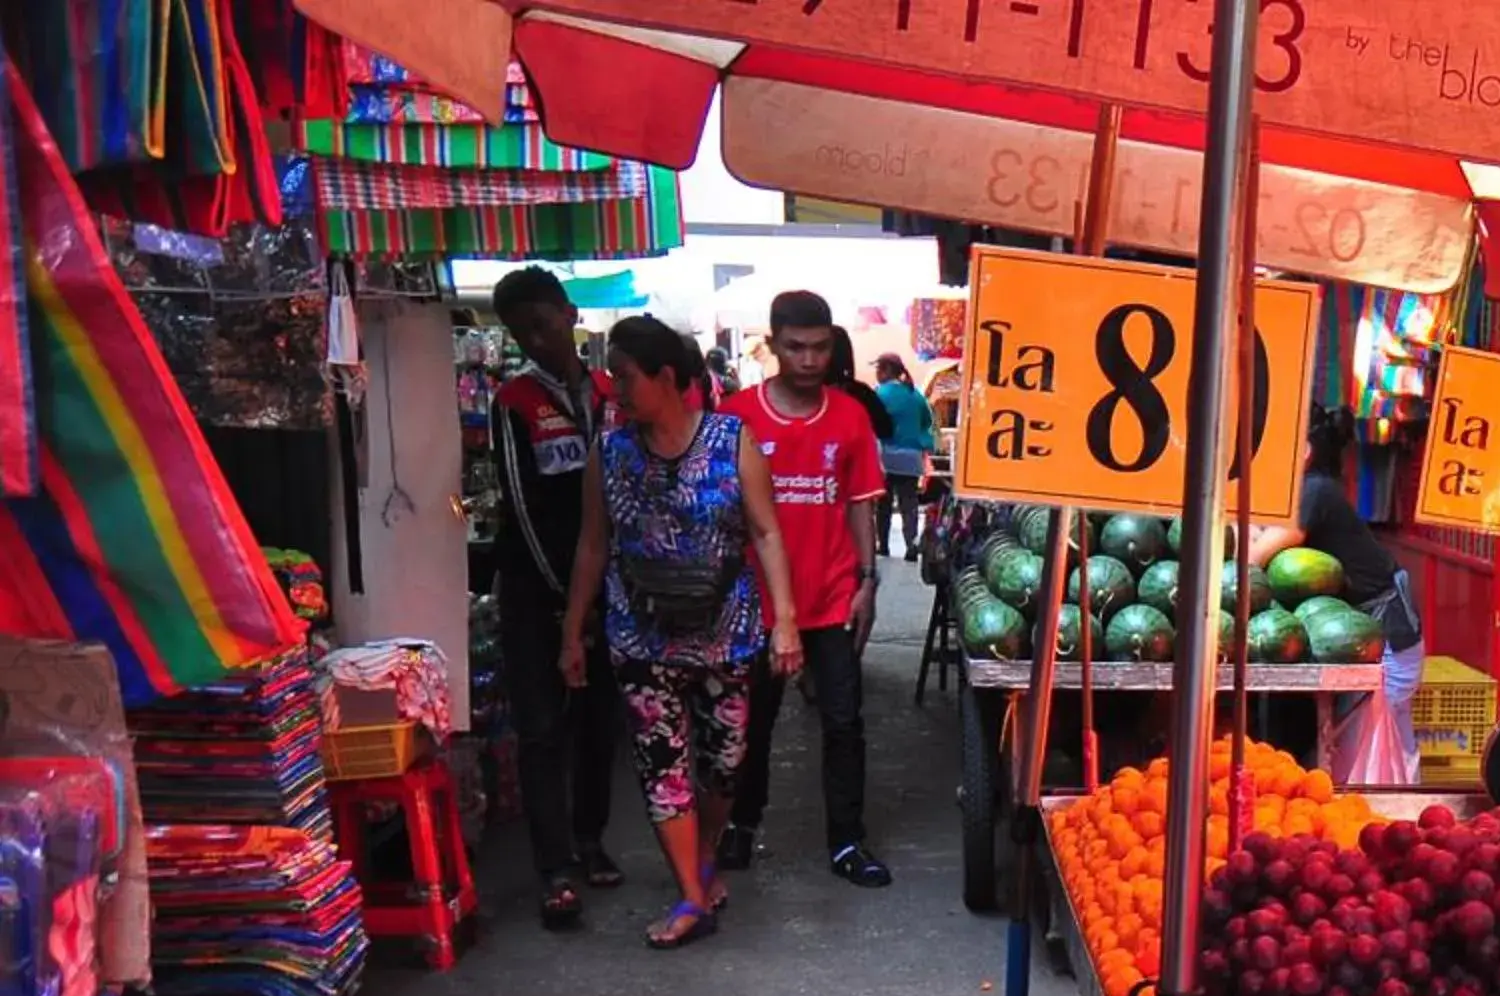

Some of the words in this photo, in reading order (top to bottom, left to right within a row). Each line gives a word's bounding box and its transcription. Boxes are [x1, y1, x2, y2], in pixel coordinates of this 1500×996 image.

[1346, 26, 1370, 55] by
[1389, 33, 1442, 67] the
[979, 319, 1056, 394] โล
[986, 409, 1055, 461] ละ
[1441, 396, 1490, 450] โล
[1438, 459, 1486, 498] ละ
